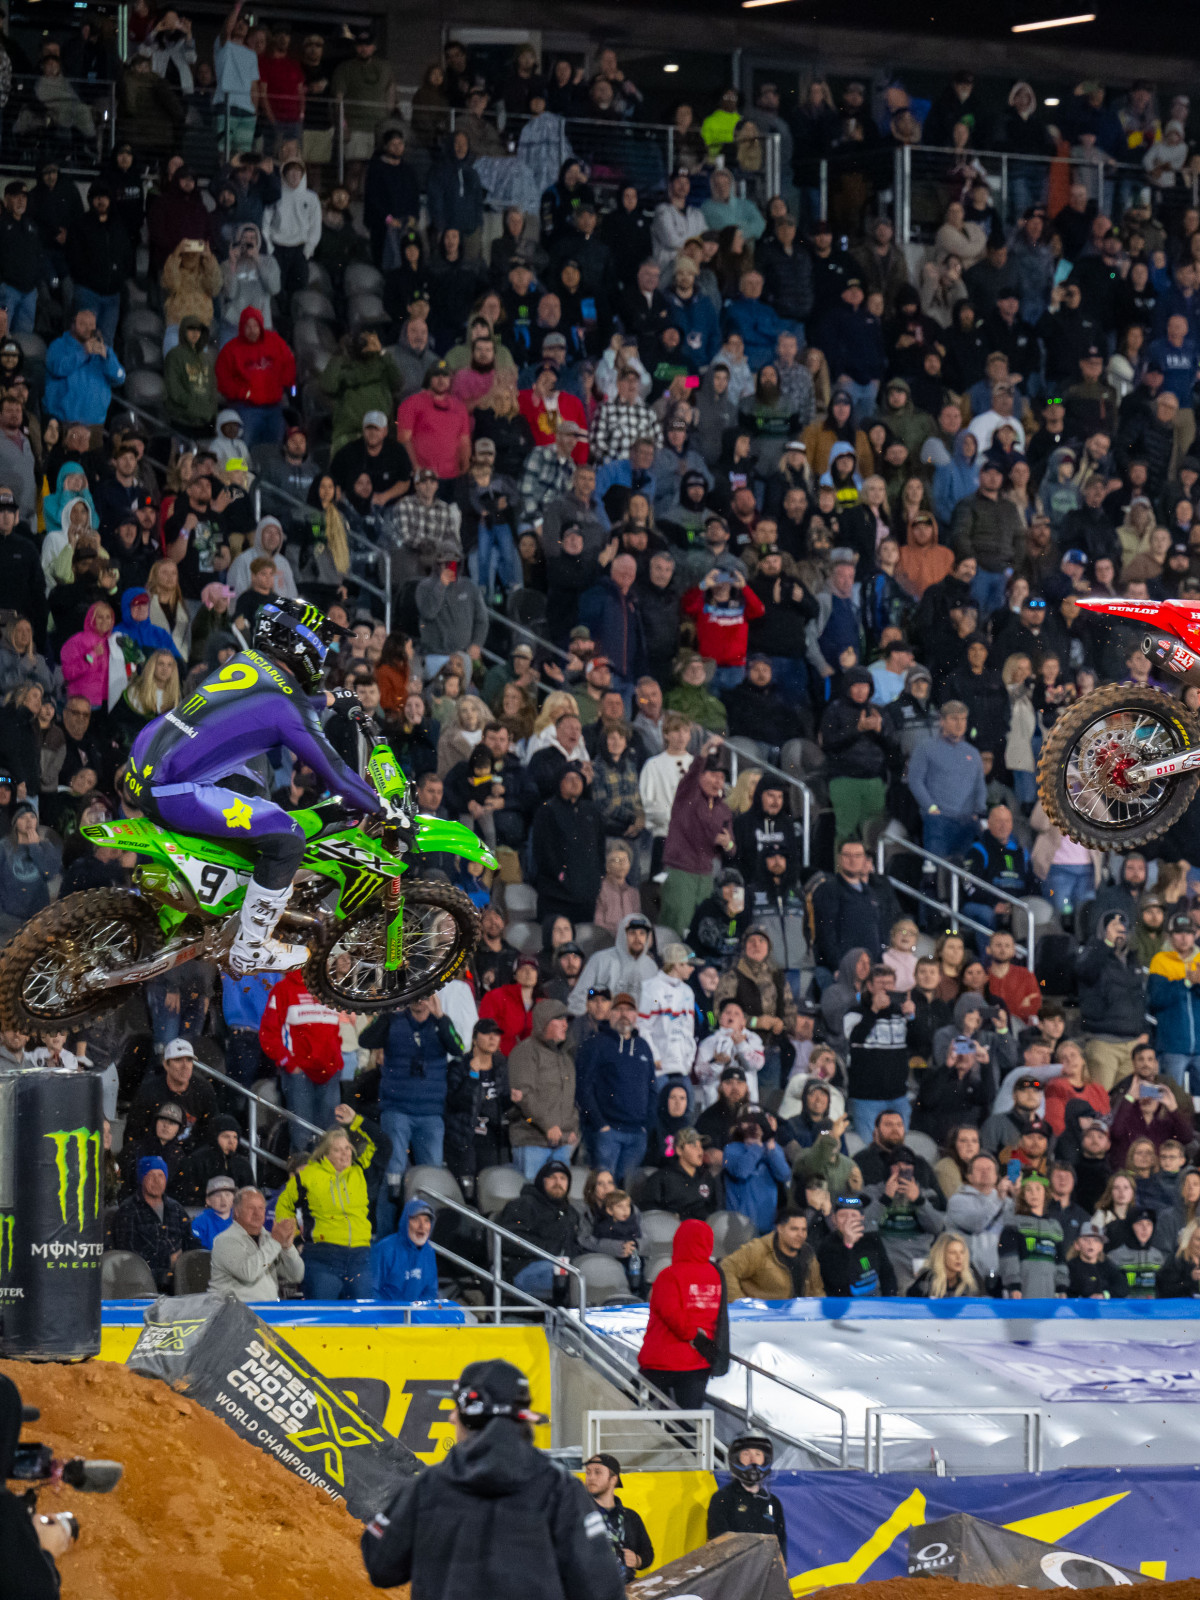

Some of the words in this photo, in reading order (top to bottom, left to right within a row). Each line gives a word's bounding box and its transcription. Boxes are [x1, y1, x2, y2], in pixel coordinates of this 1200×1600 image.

[1107, 605, 1159, 615] DUNLOP
[125, 772, 143, 797] FOX
[117, 840, 151, 849] DUNLOP
[197, 864, 229, 905] 9
[46, 1261, 101, 1269] ENERG
[240, 1358, 308, 1420] MOTO
[245, 1340, 317, 1410] SUPER
[215, 1391, 259, 1432] WORLD
[226, 1369, 304, 1435] CROSS
[908, 1555, 956, 1574] OAKLEY
